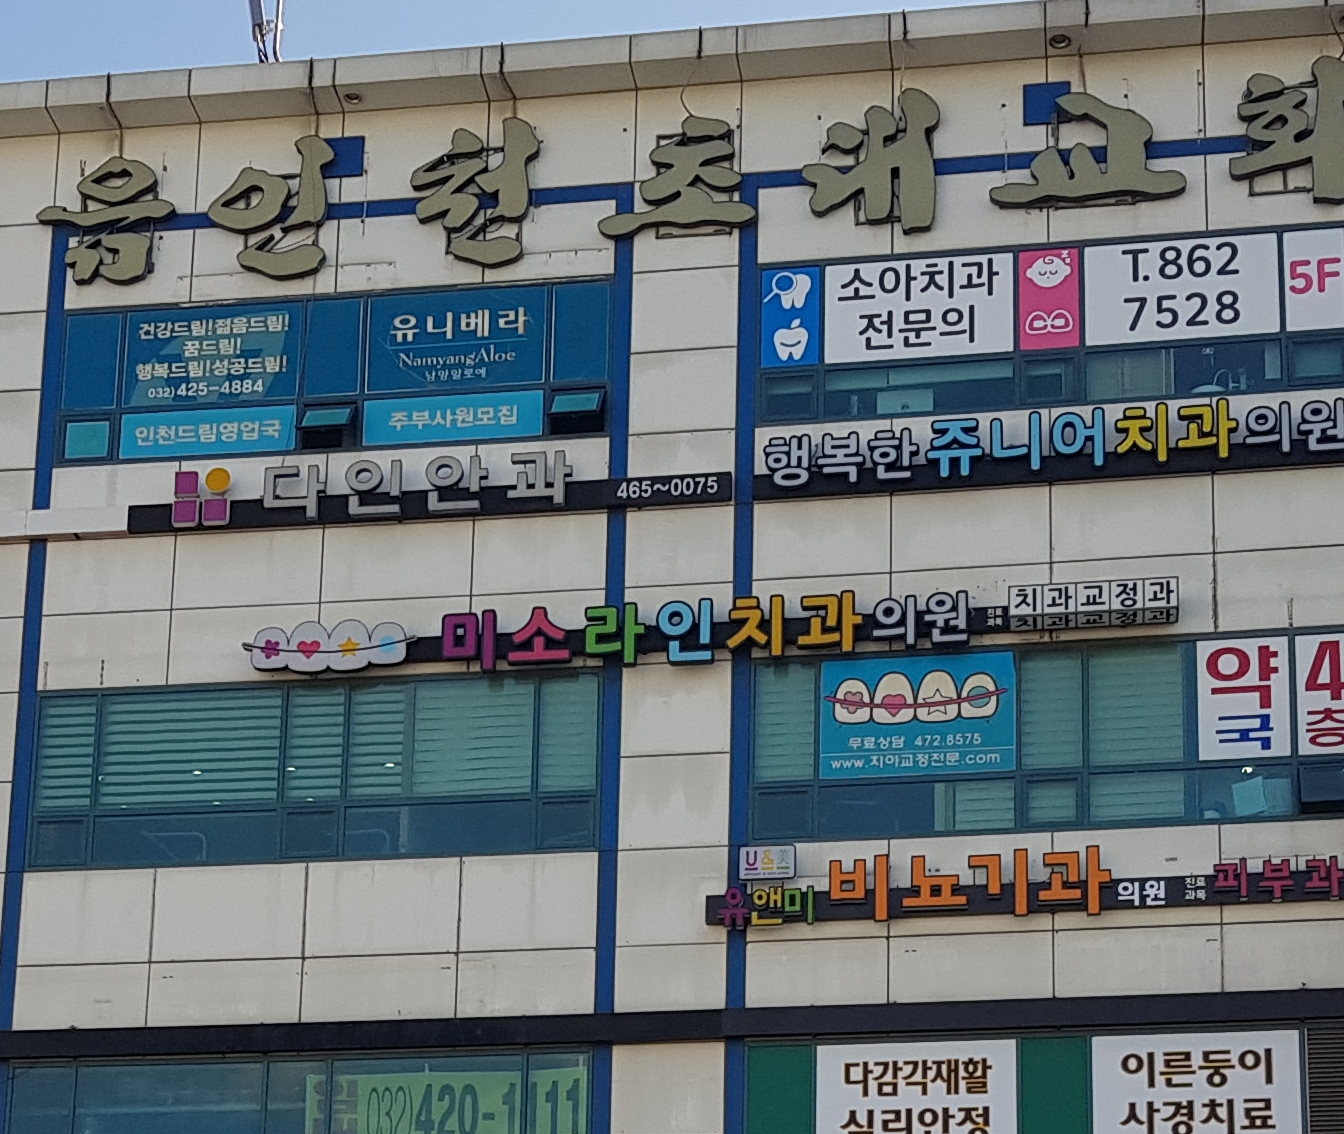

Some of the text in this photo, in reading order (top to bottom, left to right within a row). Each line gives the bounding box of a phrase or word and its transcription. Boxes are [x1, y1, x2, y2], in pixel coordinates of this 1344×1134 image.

[836, 257, 1000, 304] 소아치과
[1288, 256, 1342, 296] 5F
[389, 307, 529, 343] 유니베라
[857, 304, 977, 352] 전문의
[1123, 291, 1242, 333] 7528
[182, 336, 242, 357] 꿈드림!
[134, 419, 283, 447] 인천드림영업국
[388, 404, 519, 432] 주부사원모집
[262, 449, 573, 524] 다인안과
[848, 733, 982, 750] 무료상담 472.8575
[828, 844, 1112, 921] 비뇨기과
[1115, 879, 1167, 907] 의원
[1212, 856, 1344, 899] 피부과
[842, 1056, 993, 1098] 다감각재활
[1119, 1046, 1275, 1091] 이른둥이
